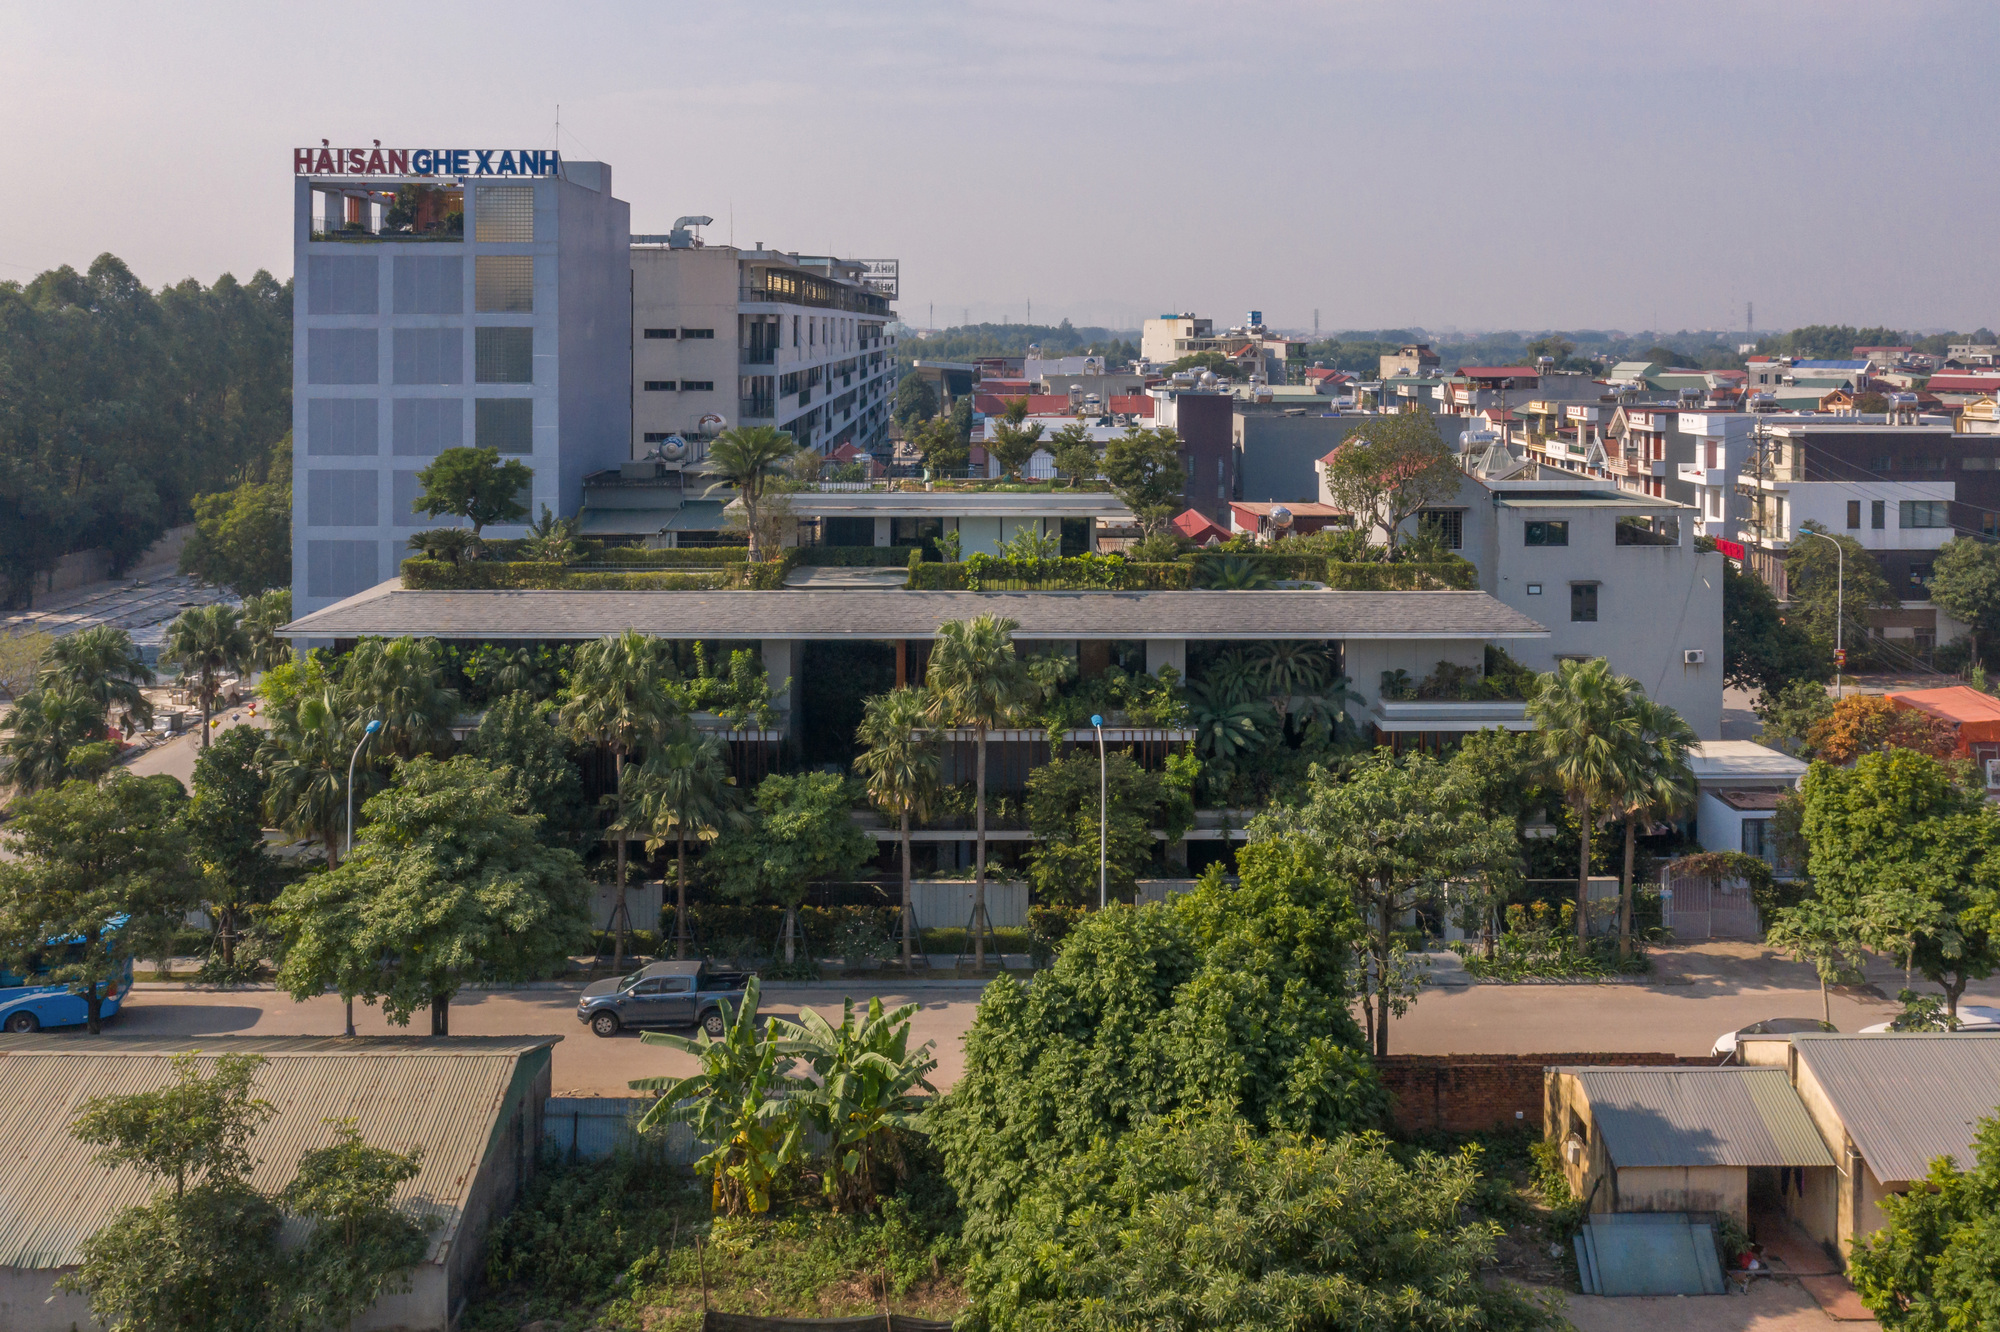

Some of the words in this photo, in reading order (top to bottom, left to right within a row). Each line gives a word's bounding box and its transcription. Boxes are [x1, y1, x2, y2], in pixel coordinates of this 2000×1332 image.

[294, 138, 344, 174] HẢI
[348, 138, 408, 174] SẢN
[475, 150, 558, 175] XANH
